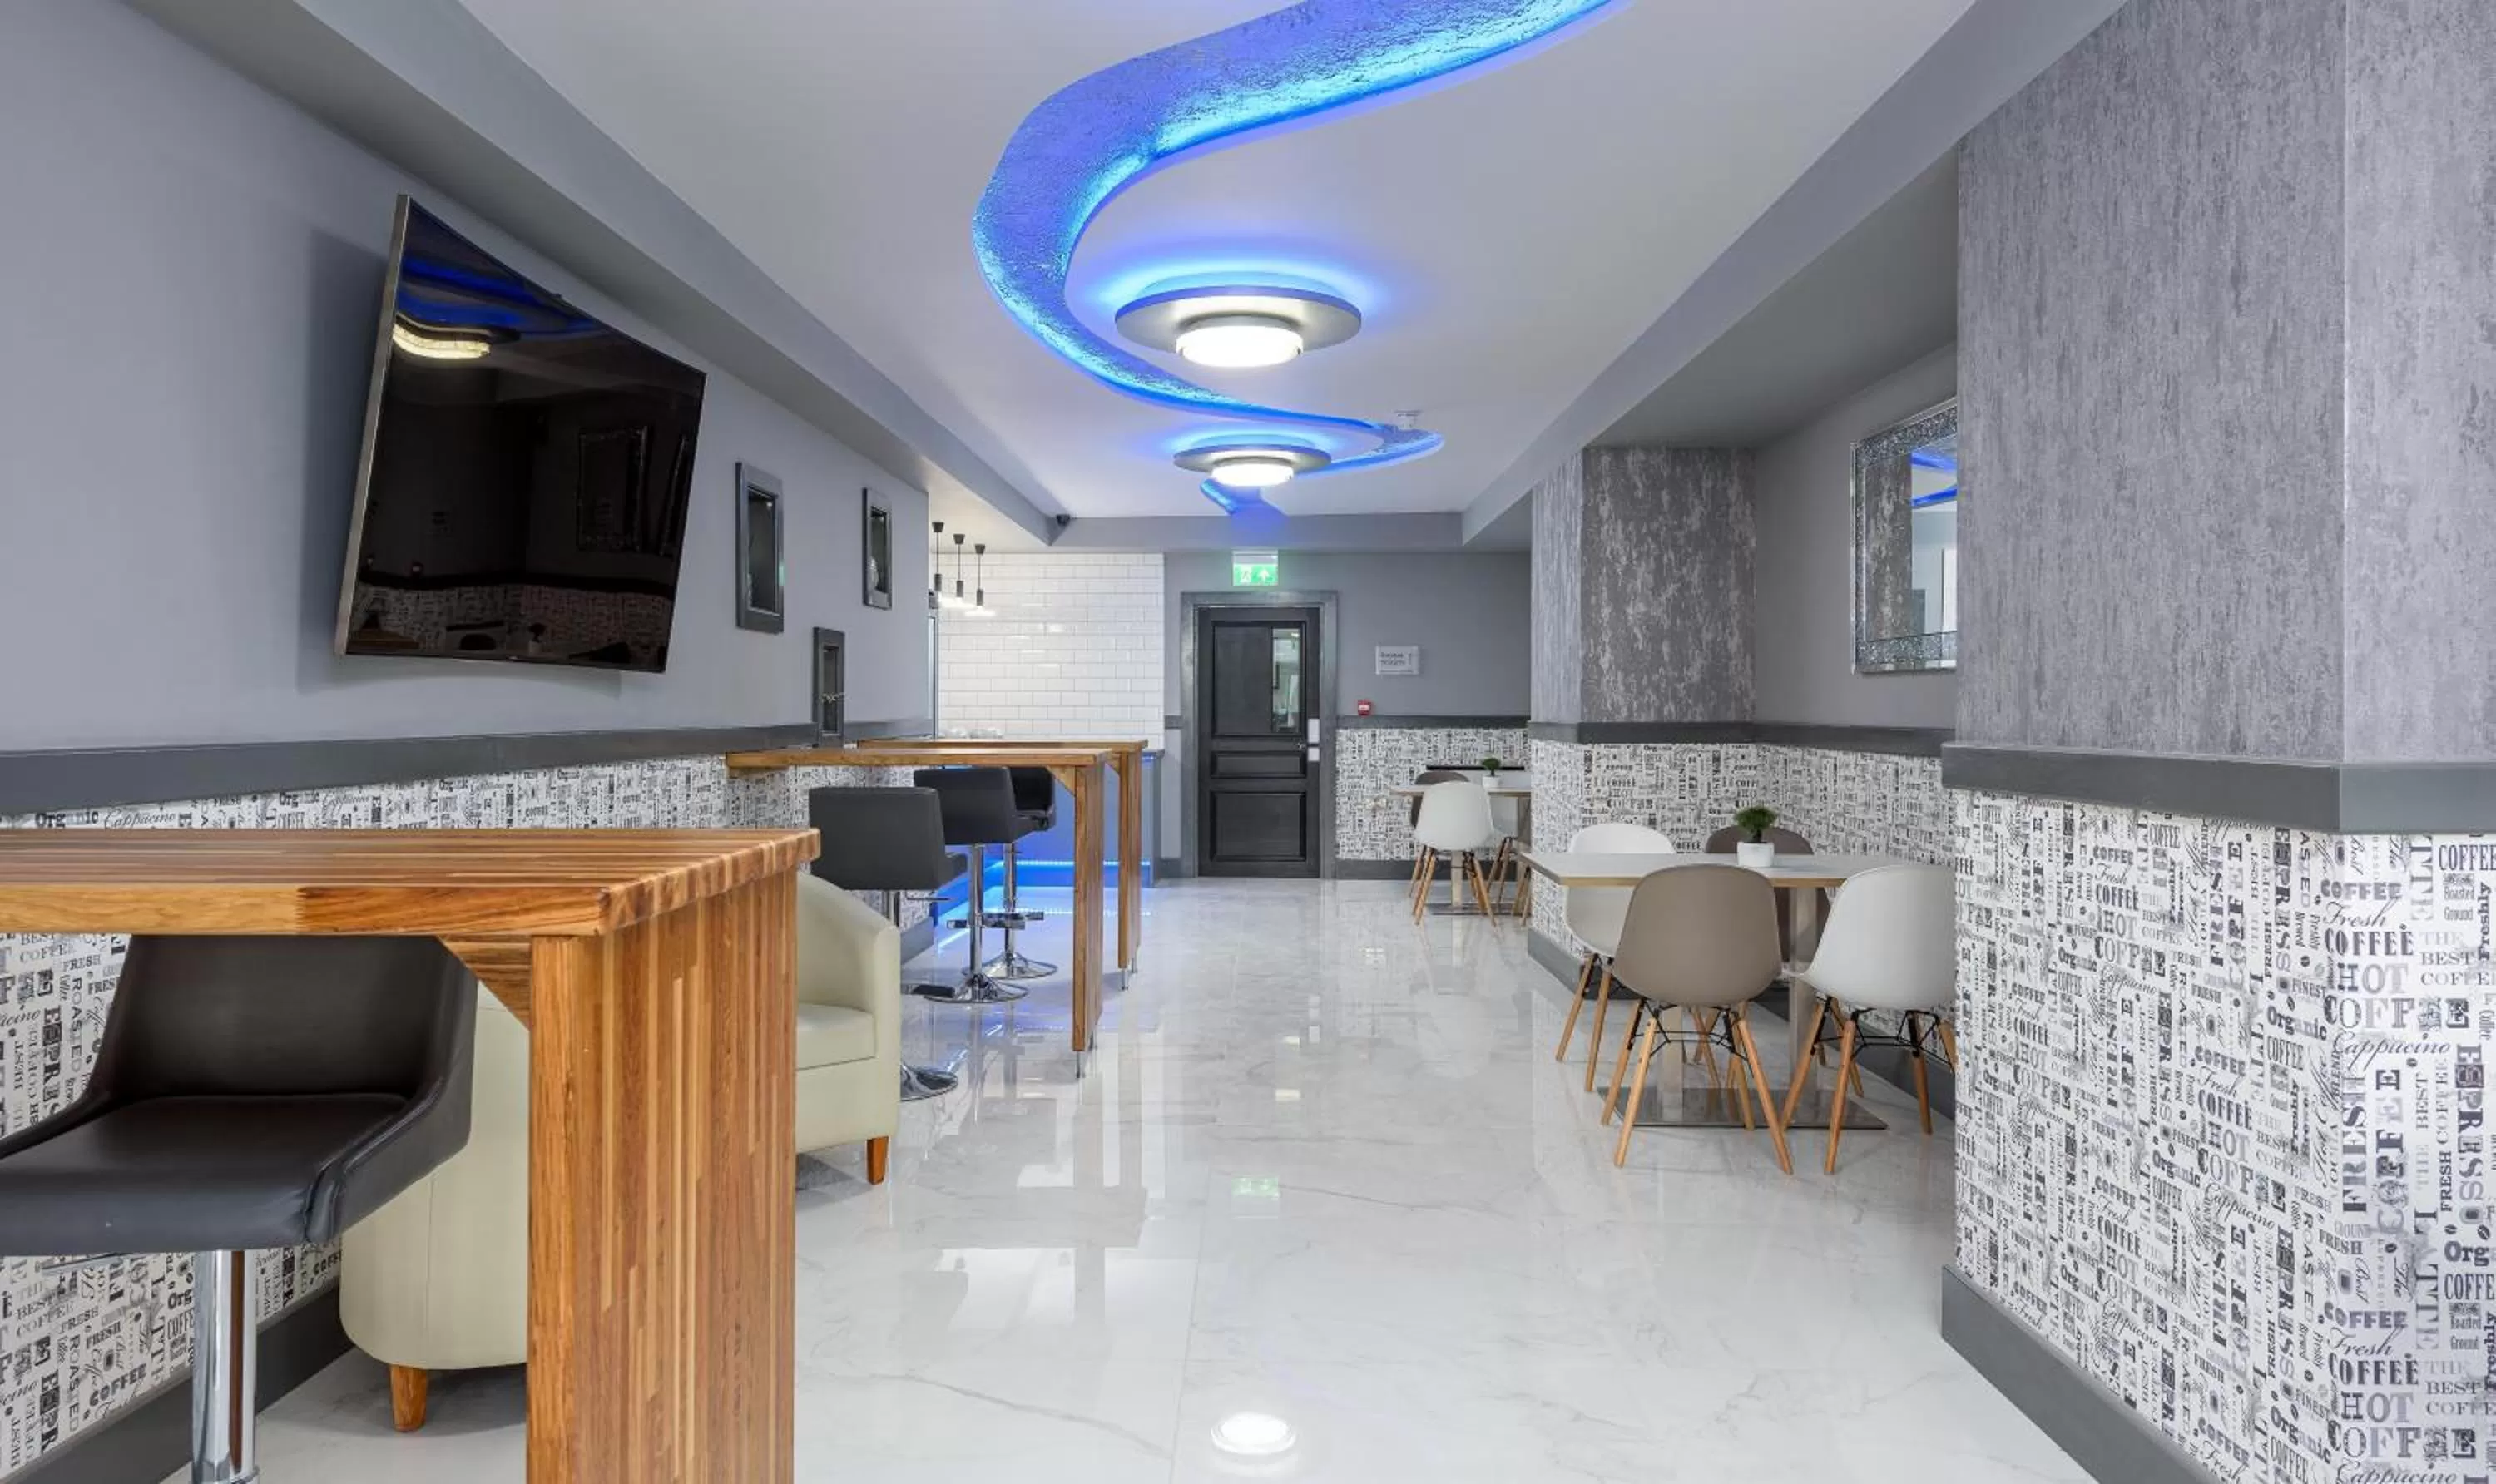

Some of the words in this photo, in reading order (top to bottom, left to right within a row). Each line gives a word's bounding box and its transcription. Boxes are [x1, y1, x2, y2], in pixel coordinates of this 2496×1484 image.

[2300, 831, 2311, 907] ASTED
[2095, 888, 2138, 914] COFFEE
[2320, 878, 2403, 900] COFFEE
[2323, 898, 2399, 928] Fresh
[2443, 907, 2474, 922] Ground
[2477, 881, 2492, 962] Freshly
[2324, 927, 2414, 956] COFFEE
[62, 955, 102, 972] FRESH
[2419, 951, 2474, 966] BEST
[87, 977, 117, 996] FRES
[2336, 962, 2409, 995] HOT
[70, 976, 83, 1074] ROASTED
[2266, 1004, 2327, 1041] Organic
[2266, 1034, 2304, 1071] COFFEE
[2197, 1089, 2251, 1131] COFFEE
[2414, 1071, 2429, 1130] BEST
[2341, 1075, 2368, 1212] FRESH
[2454, 1044, 2485, 1225] ESPRESSO
[2438, 1150, 2453, 1212] FRESH
[2097, 1214, 2140, 1259] COFFEE
[2318, 1228, 2364, 1255] FRESH
[2304, 1209, 2315, 1322] ROASTED
[2444, 1273, 2495, 1301] COFFE
[2323, 1299, 2408, 1329] COFFEE
[2327, 1326, 2406, 1356] Fresh
[69, 1333, 81, 1432] ROASTED
[89, 1363, 147, 1407] COFFEE
[2329, 1352, 2419, 1386] COFFEE
[2425, 1380, 2480, 1396] BEST
[2340, 1390, 2414, 1423] HOT
[2425, 1401, 2496, 1416] COFFE
[2271, 1404, 2334, 1467] Organic
